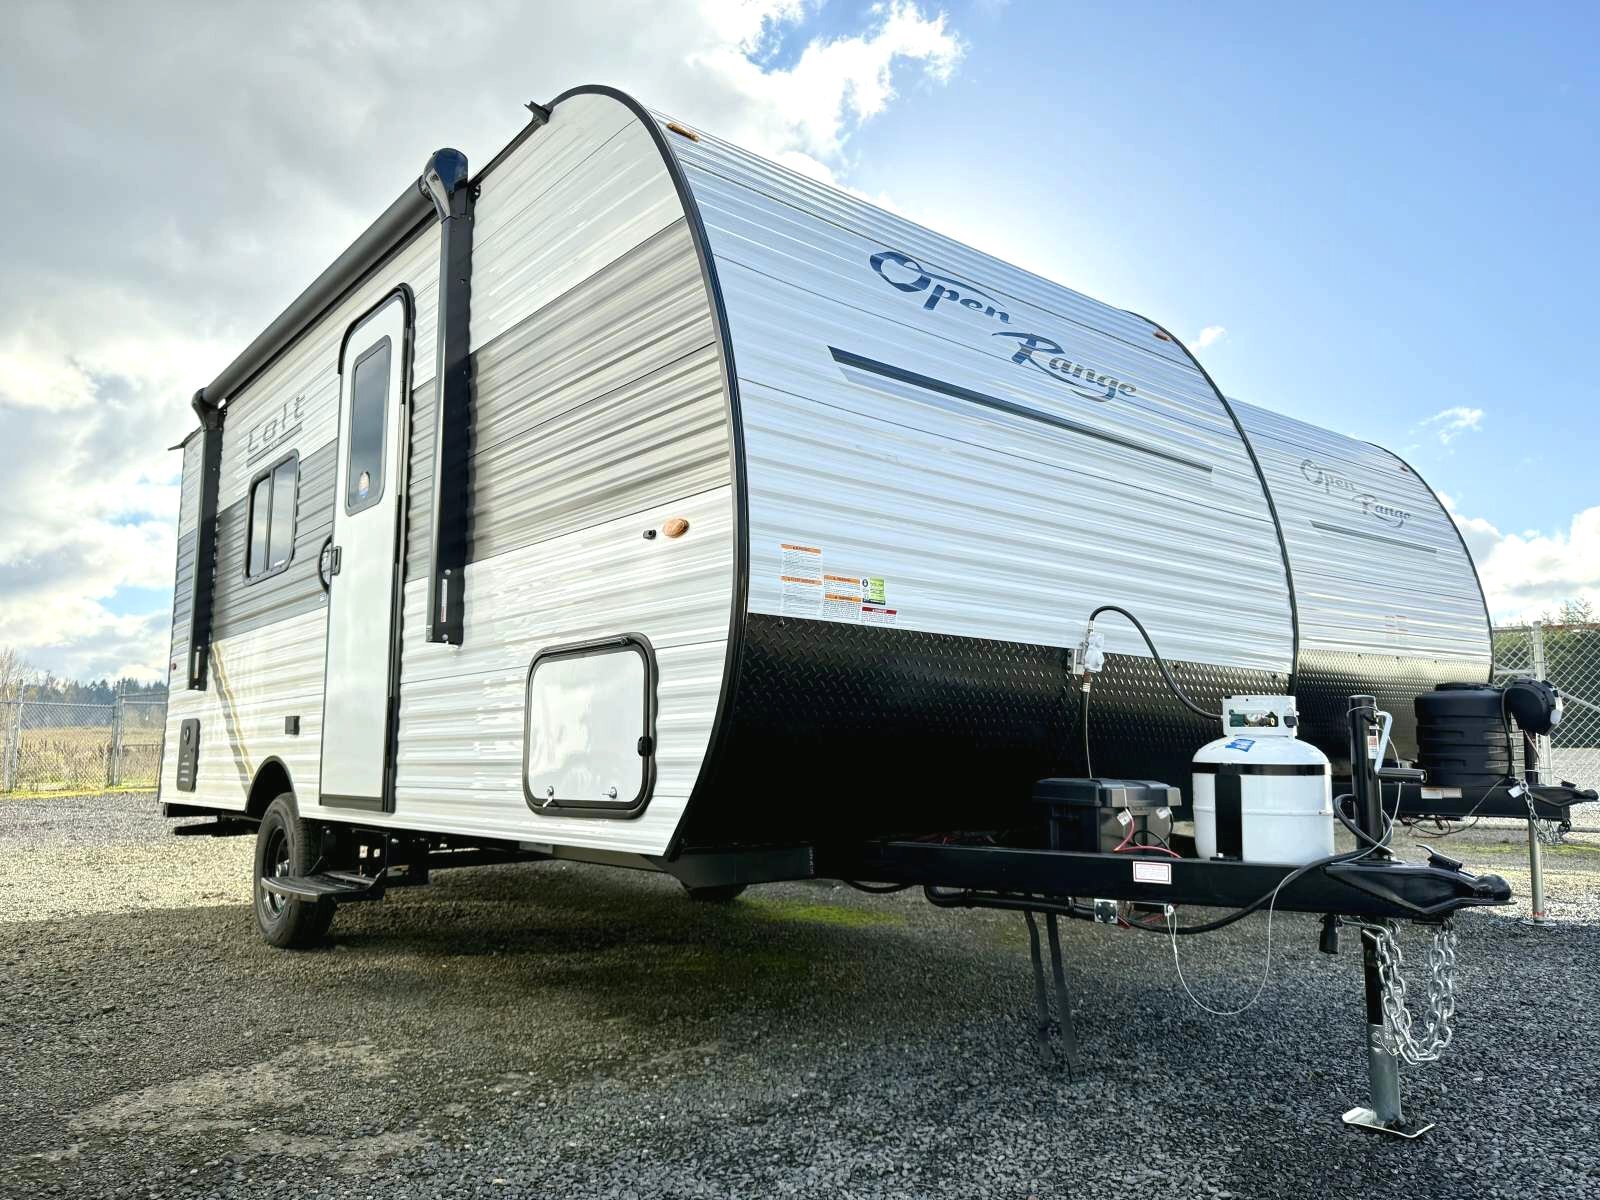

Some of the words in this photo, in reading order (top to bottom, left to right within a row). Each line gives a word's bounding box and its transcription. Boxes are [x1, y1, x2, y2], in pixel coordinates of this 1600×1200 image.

[870, 251, 1012, 324] Open
[992, 331, 1137, 402] Range
[1300, 459, 1356, 494] Open
[1352, 493, 1412, 528] Range
